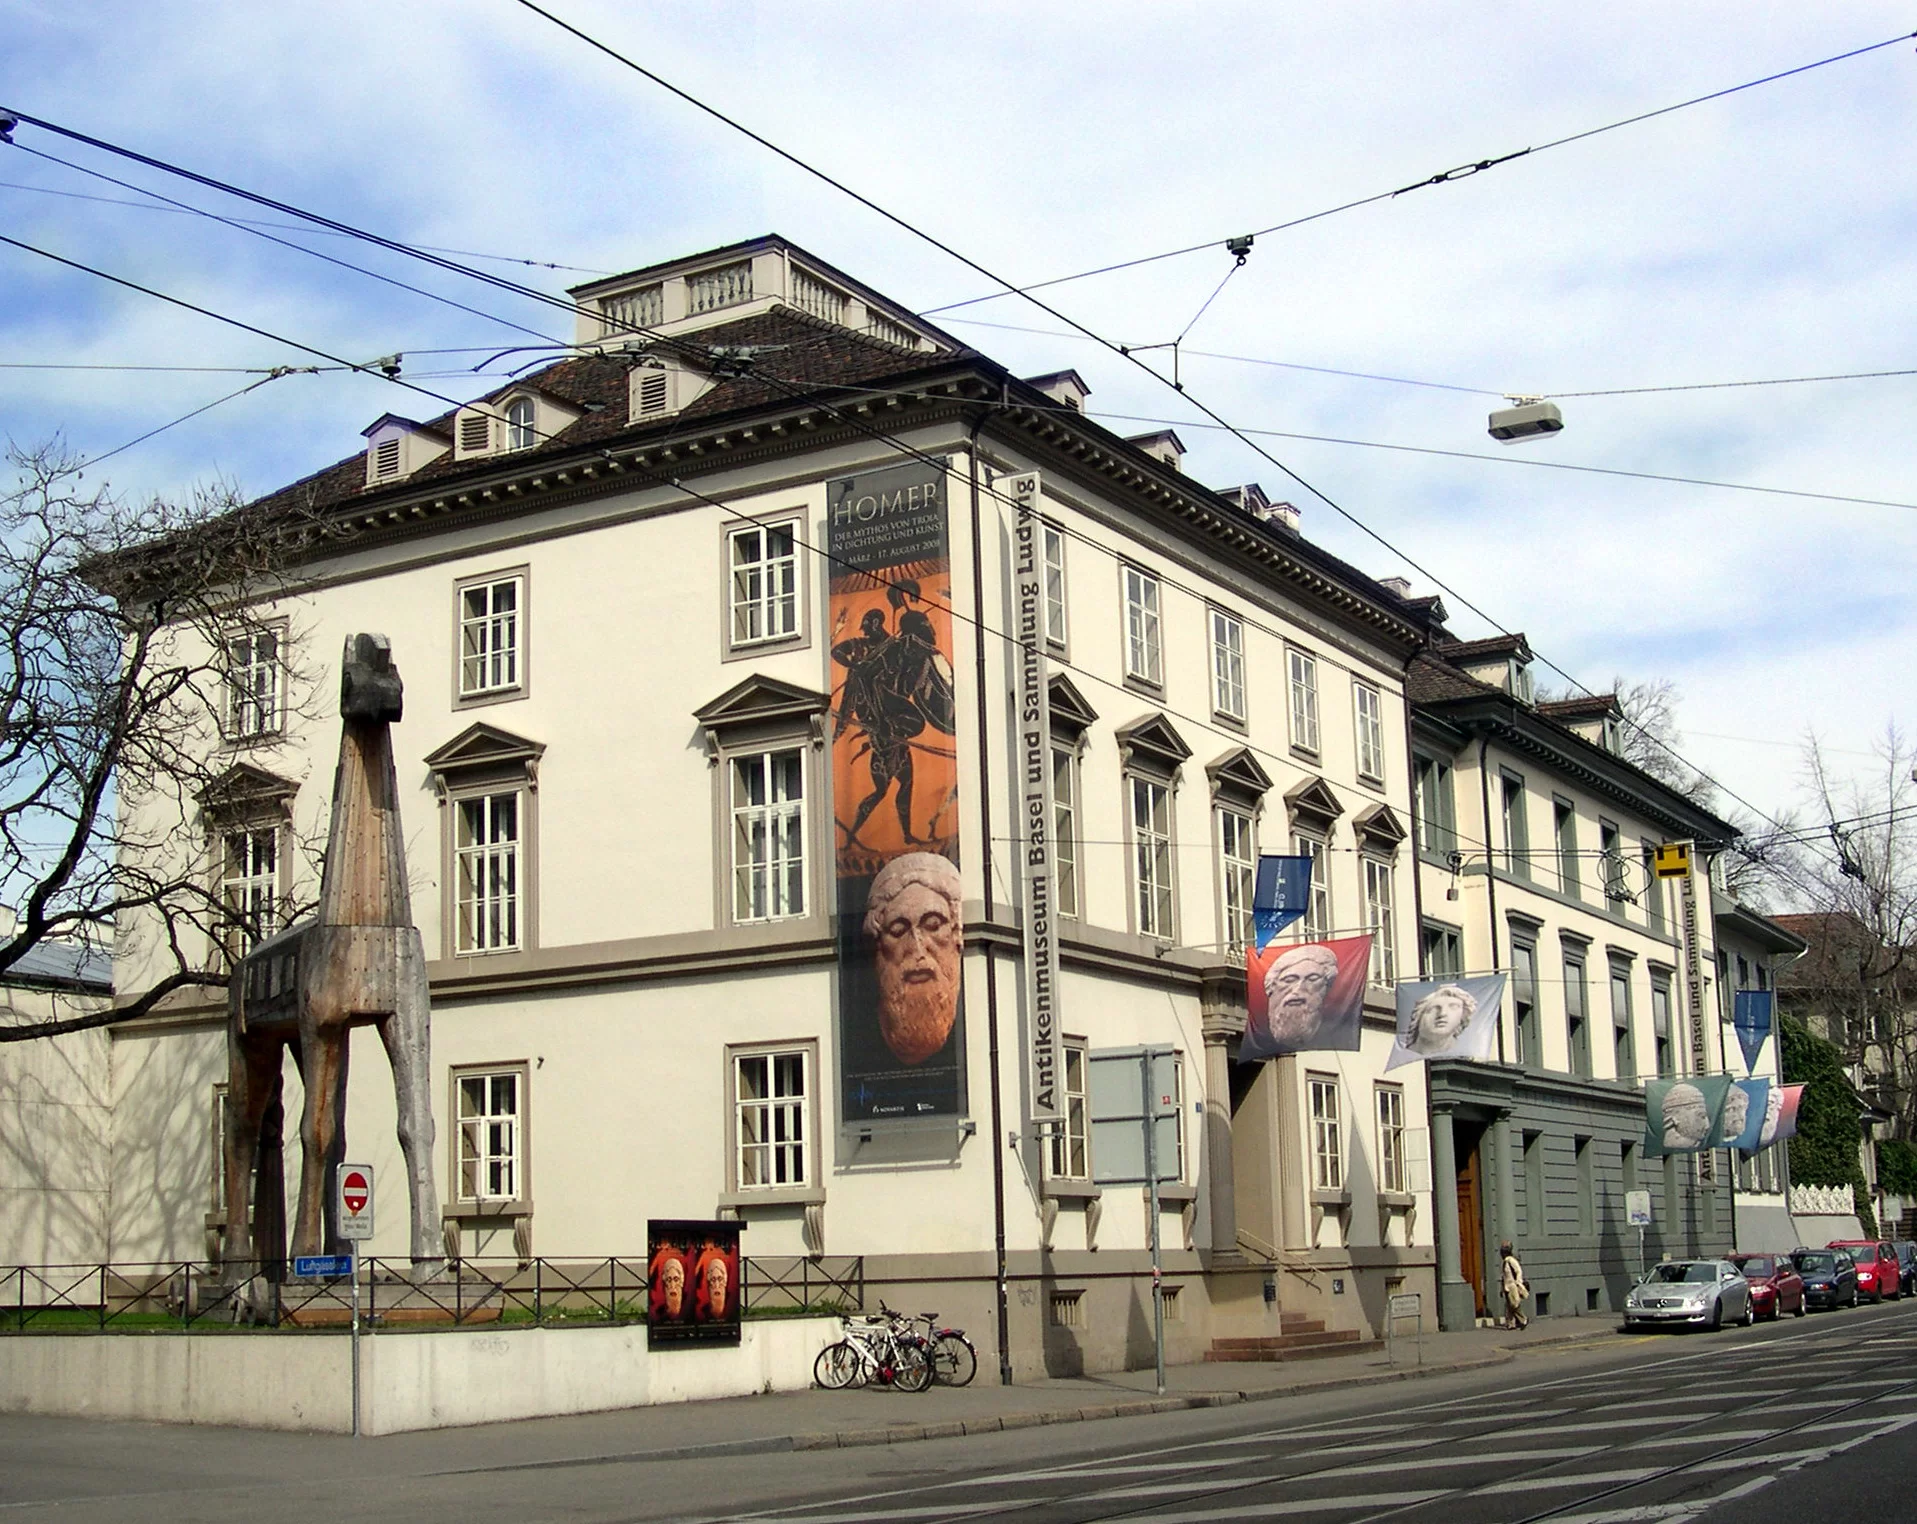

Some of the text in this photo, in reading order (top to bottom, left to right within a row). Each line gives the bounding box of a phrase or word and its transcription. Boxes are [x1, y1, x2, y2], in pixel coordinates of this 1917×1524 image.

[833, 482, 944, 527] HOMER
[832, 522, 945, 553] IN DICHTUNG UND KUNST
[834, 513, 940, 542] DER MYTHOS VON TROIA
[1015, 479, 1055, 1110] Antikenmuseum Basel und Sammlung Ludwig
[1684, 900, 1698, 977] Sammlung
[1688, 981, 1700, 1010] und
[1691, 1014, 1704, 1053] Basel
